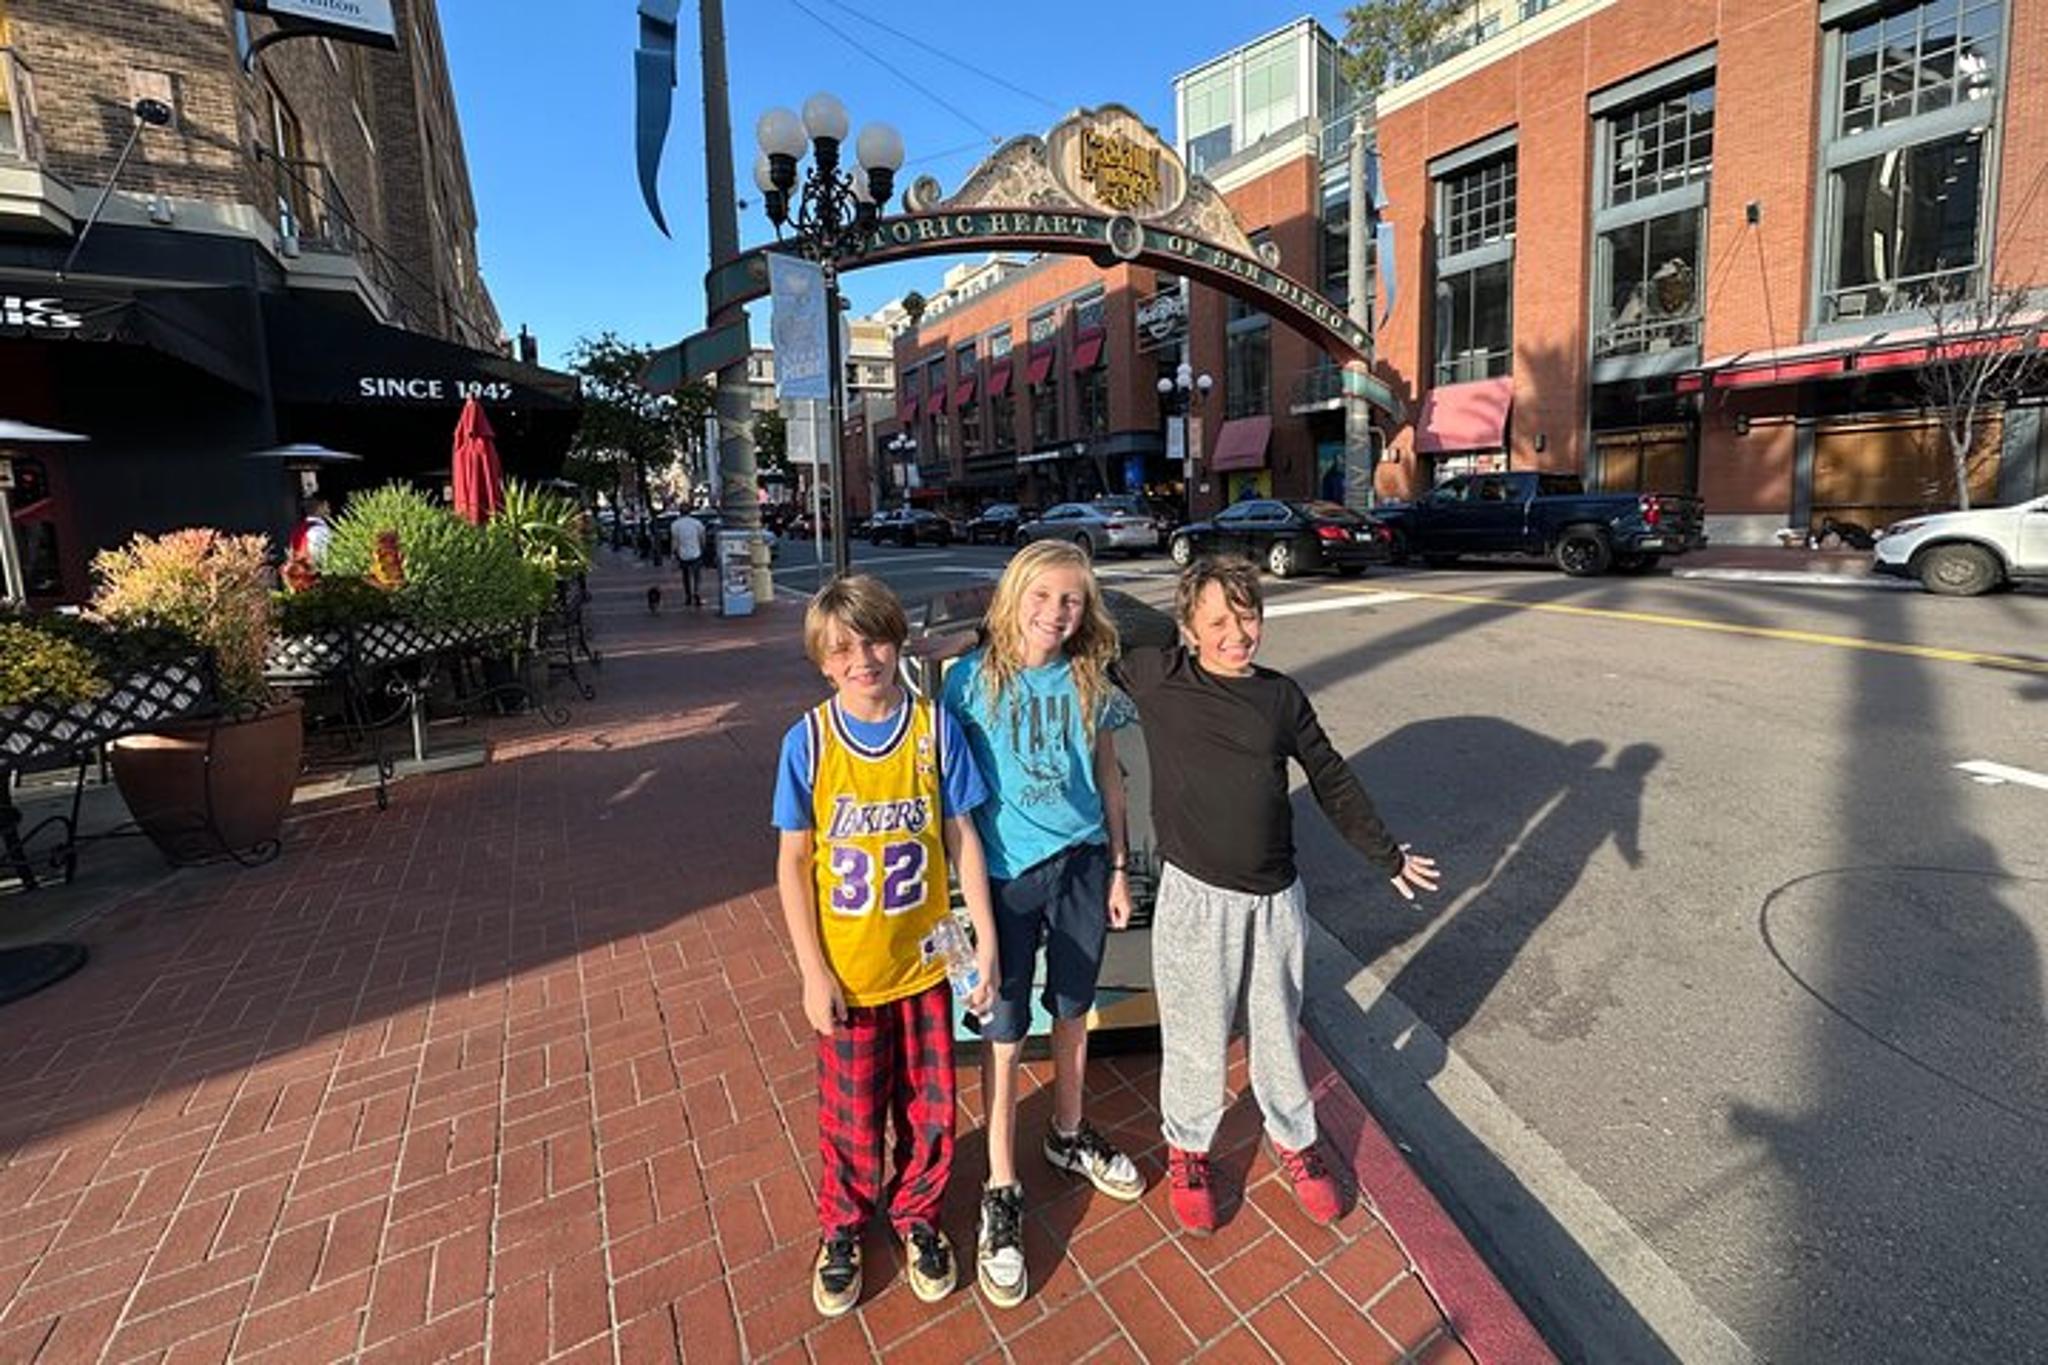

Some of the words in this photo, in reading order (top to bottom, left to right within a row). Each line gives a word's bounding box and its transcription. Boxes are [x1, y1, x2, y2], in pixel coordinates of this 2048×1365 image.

[989, 212, 1088, 234] HEART
[1167, 236, 1199, 257] OF
[1213, 249, 1260, 281] SAN
[1276, 278, 1342, 329] DIEGO
[359, 377, 444, 399] SINCE
[831, 840, 928, 916] 32
